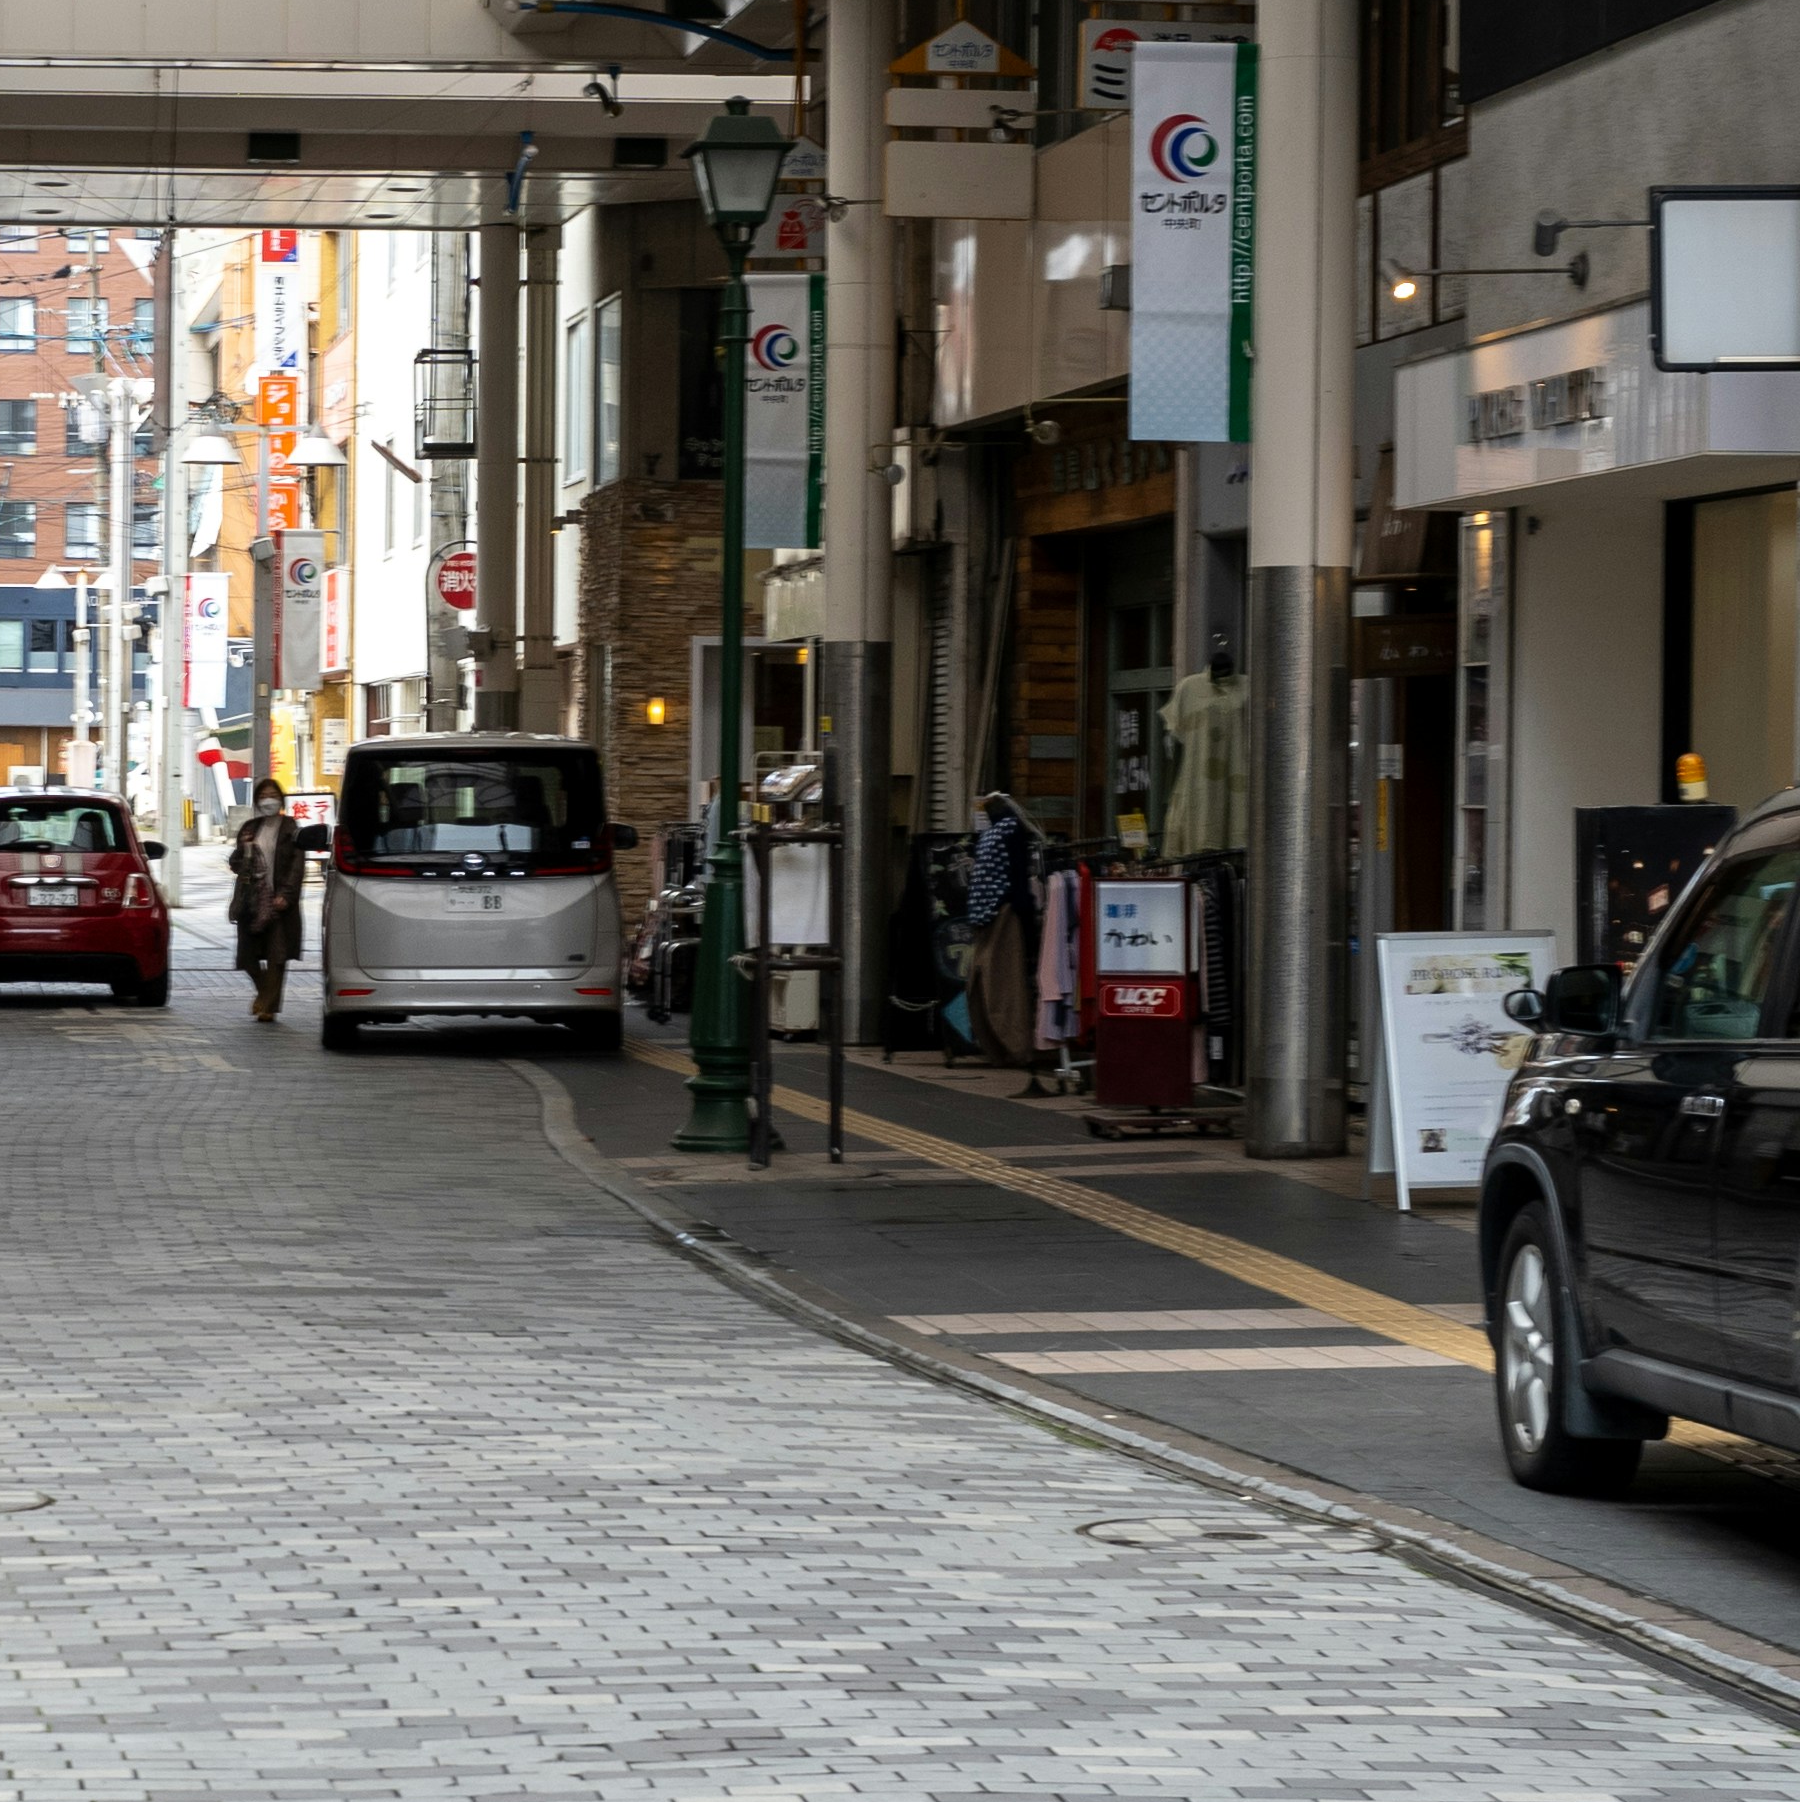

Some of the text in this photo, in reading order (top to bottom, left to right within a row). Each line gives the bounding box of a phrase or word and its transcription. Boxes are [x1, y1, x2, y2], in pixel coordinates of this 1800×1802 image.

[1139, 190, 1228, 215] セントポルタ
[1232, 95, 1255, 304] http://centporta.com
[440, 570, 477, 593] 消火
[1103, 927, 1174, 948] かわい
[1113, 987, 1168, 1006] UCC
